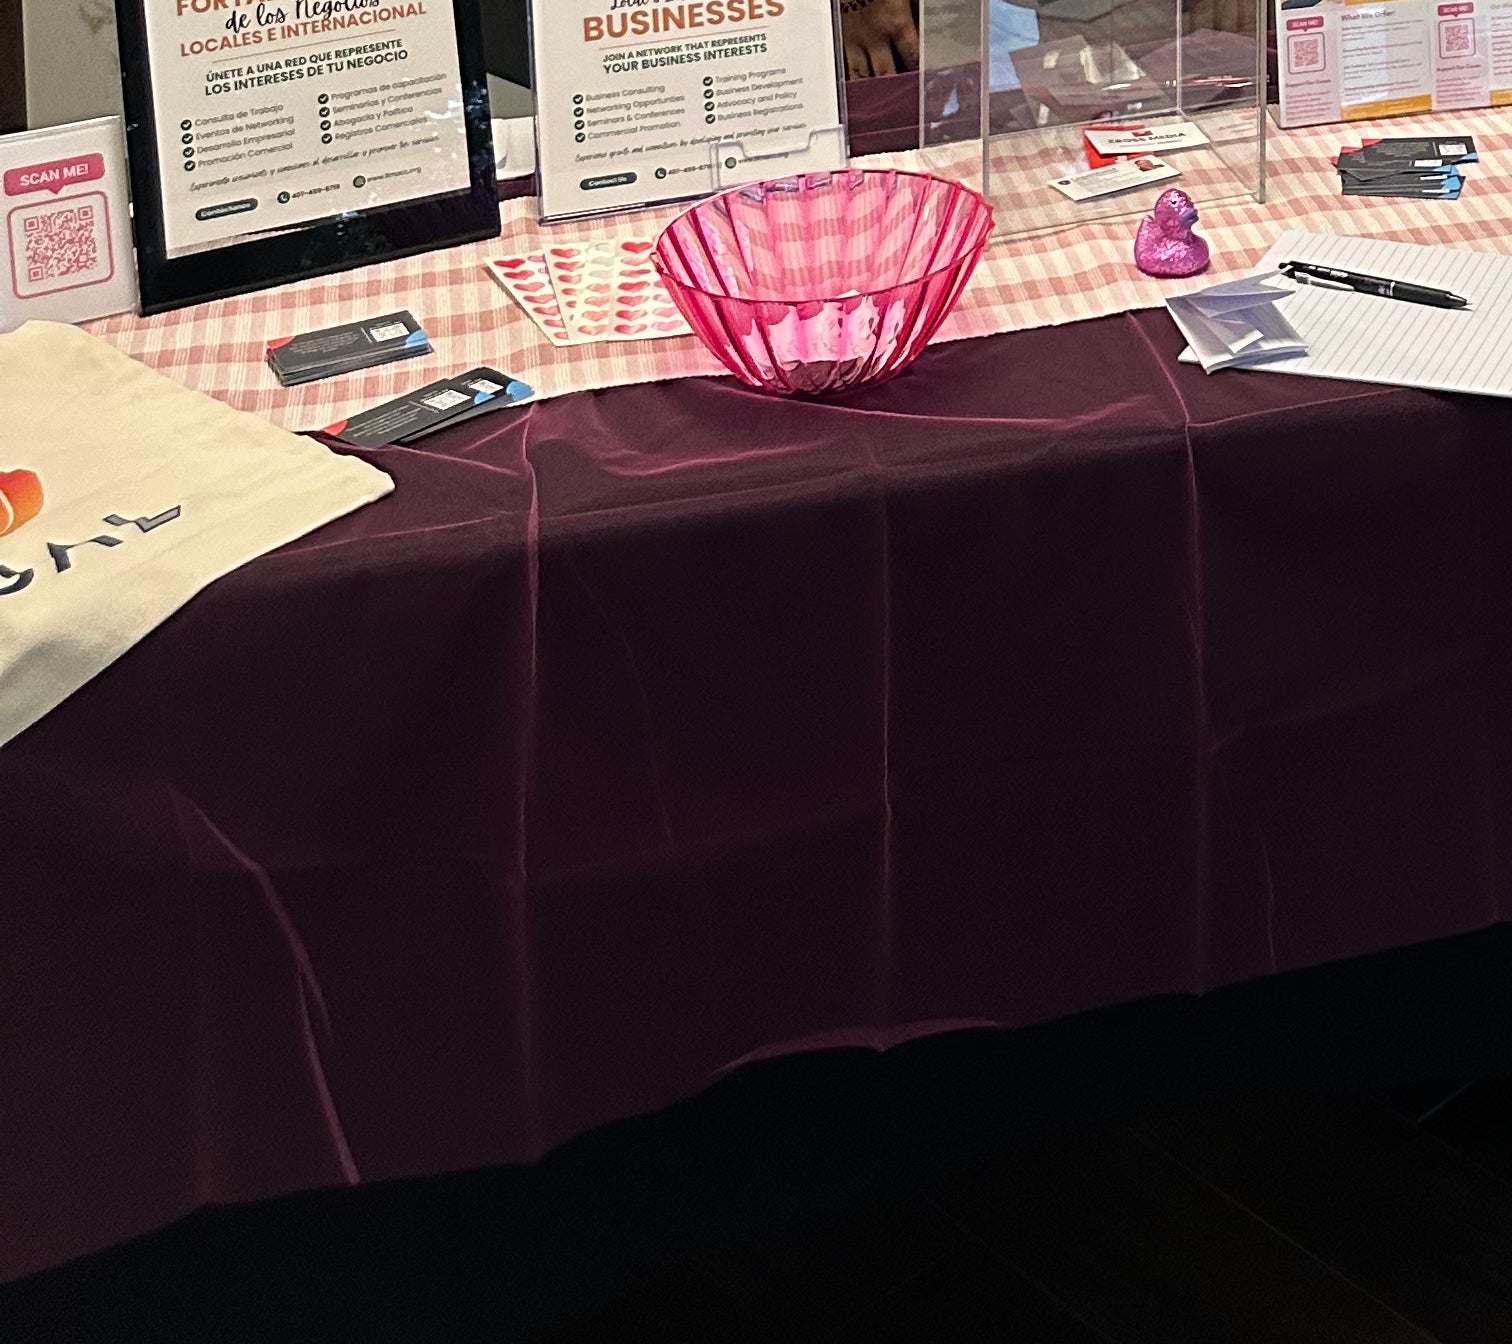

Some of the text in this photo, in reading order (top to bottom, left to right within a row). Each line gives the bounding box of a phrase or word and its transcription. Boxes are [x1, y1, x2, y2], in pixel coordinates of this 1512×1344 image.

[180, 1, 427, 57] LOCALES E INTERNACIONAL
[225, 10, 251, 33] de
[256, 3, 287, 26] los
[602, 33, 767, 63] JOIN A NETWORK THAT REPRESENTS
[603, 43, 768, 74] YOUR BUSINESS INTERESTS
[206, 38, 404, 82] ÚNETE A UNA RED QUE REPRESENTE
[205, 49, 409, 96] LOS INTERESES DE TU NEGOCIO
[715, 73, 747, 83] Training
[331, 86, 378, 100] Programas
[379, 83, 391, 91] de
[716, 78, 803, 96] Business Development
[332, 98, 380, 114] Seminarios
[387, 87, 443, 103] Conferencias
[717, 91, 797, 108] Advocacy and Policy
[194, 104, 284, 127] Consulta de Trabajo
[587, 116, 625, 127] Seminars
[634, 108, 685, 121] Conferences
[717, 110, 752, 121] Business
[195, 115, 295, 140] Eventos de Networking
[334, 126, 374, 140] Registros
[588, 121, 681, 140] Commercial Promotion
[197, 128, 296, 154] Desarrollo Empresarial
[20, 163, 89, 186] SCAN ME!
